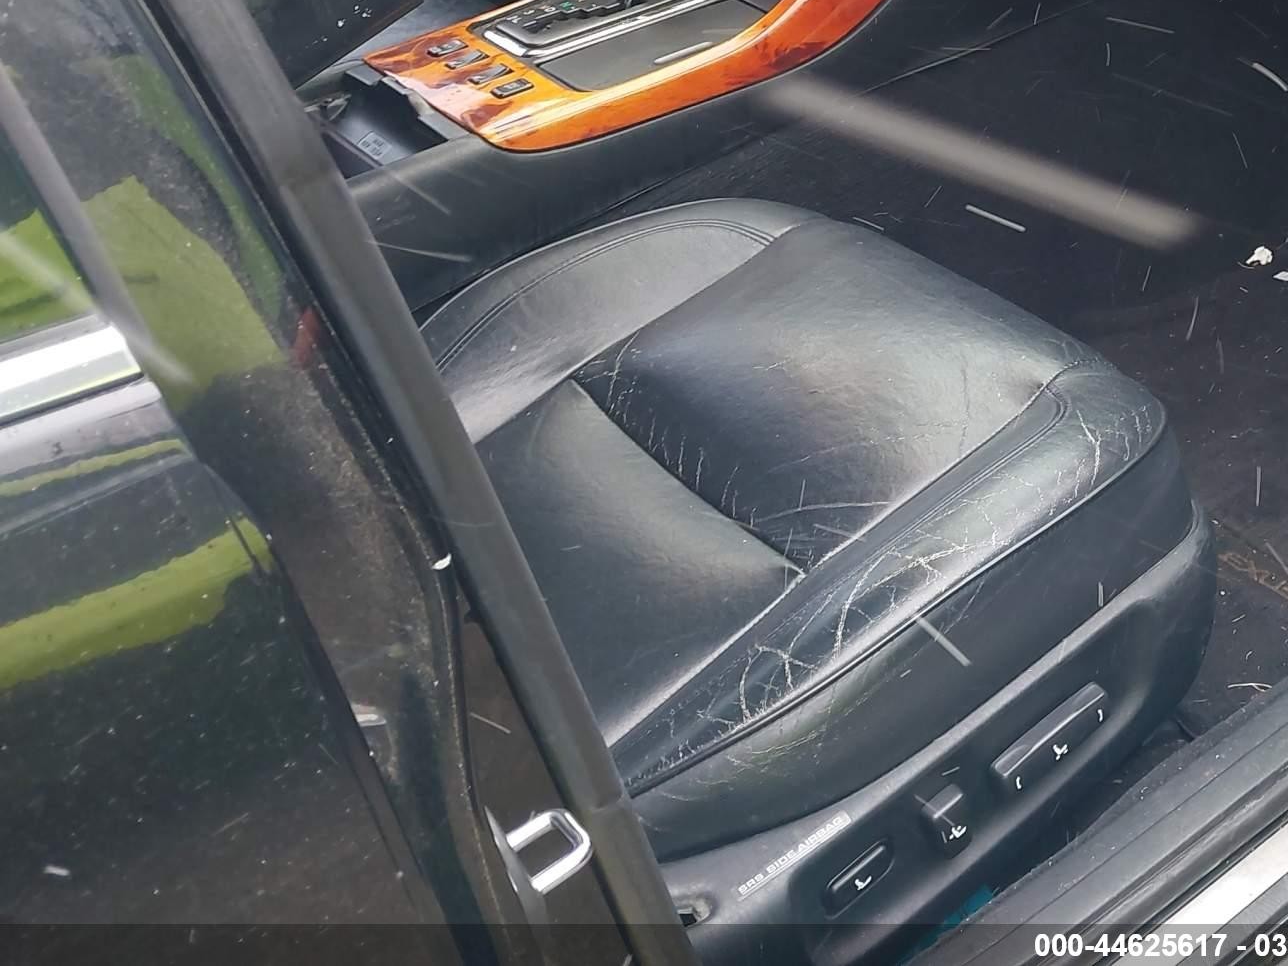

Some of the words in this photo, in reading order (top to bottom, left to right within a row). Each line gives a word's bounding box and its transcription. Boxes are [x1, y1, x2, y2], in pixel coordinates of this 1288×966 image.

[738, 874, 764, 895] SRS
[766, 849, 796, 874] SIDE
[798, 815, 843, 853] AIRBAG
